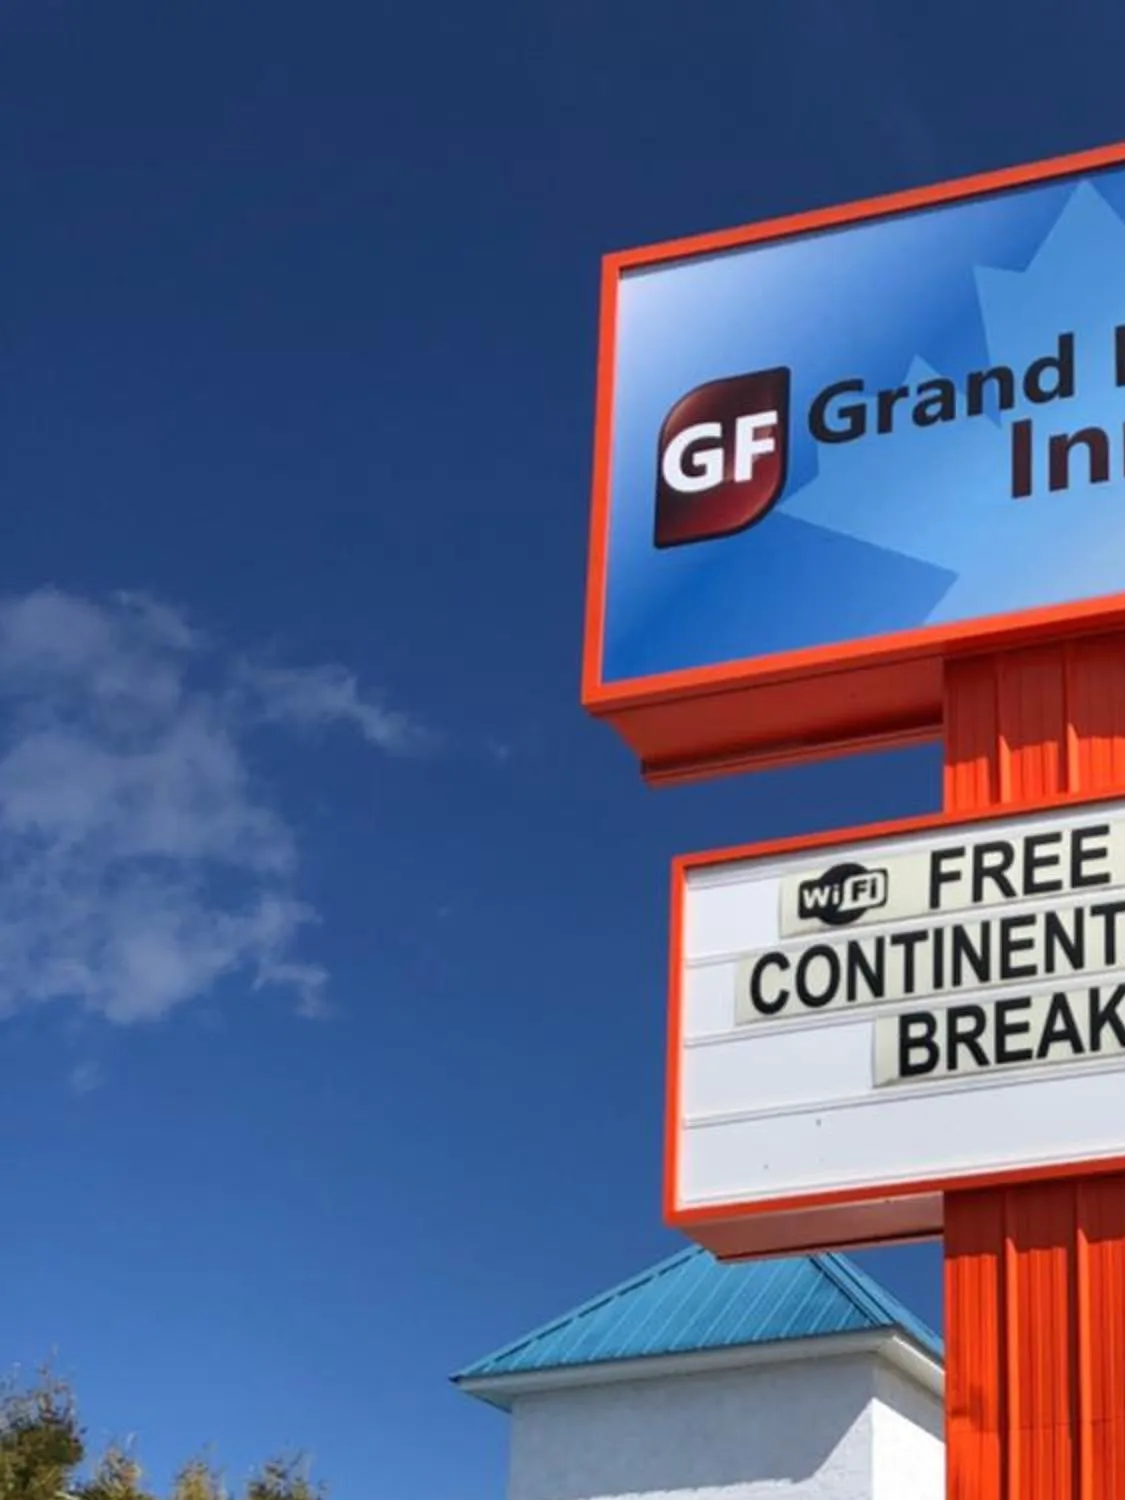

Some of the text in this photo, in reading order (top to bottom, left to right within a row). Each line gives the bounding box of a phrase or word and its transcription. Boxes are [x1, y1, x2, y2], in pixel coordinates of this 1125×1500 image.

[808, 332, 1076, 445] Grand
[661, 410, 778, 494] GF
[928, 824, 1112, 910] FREE
